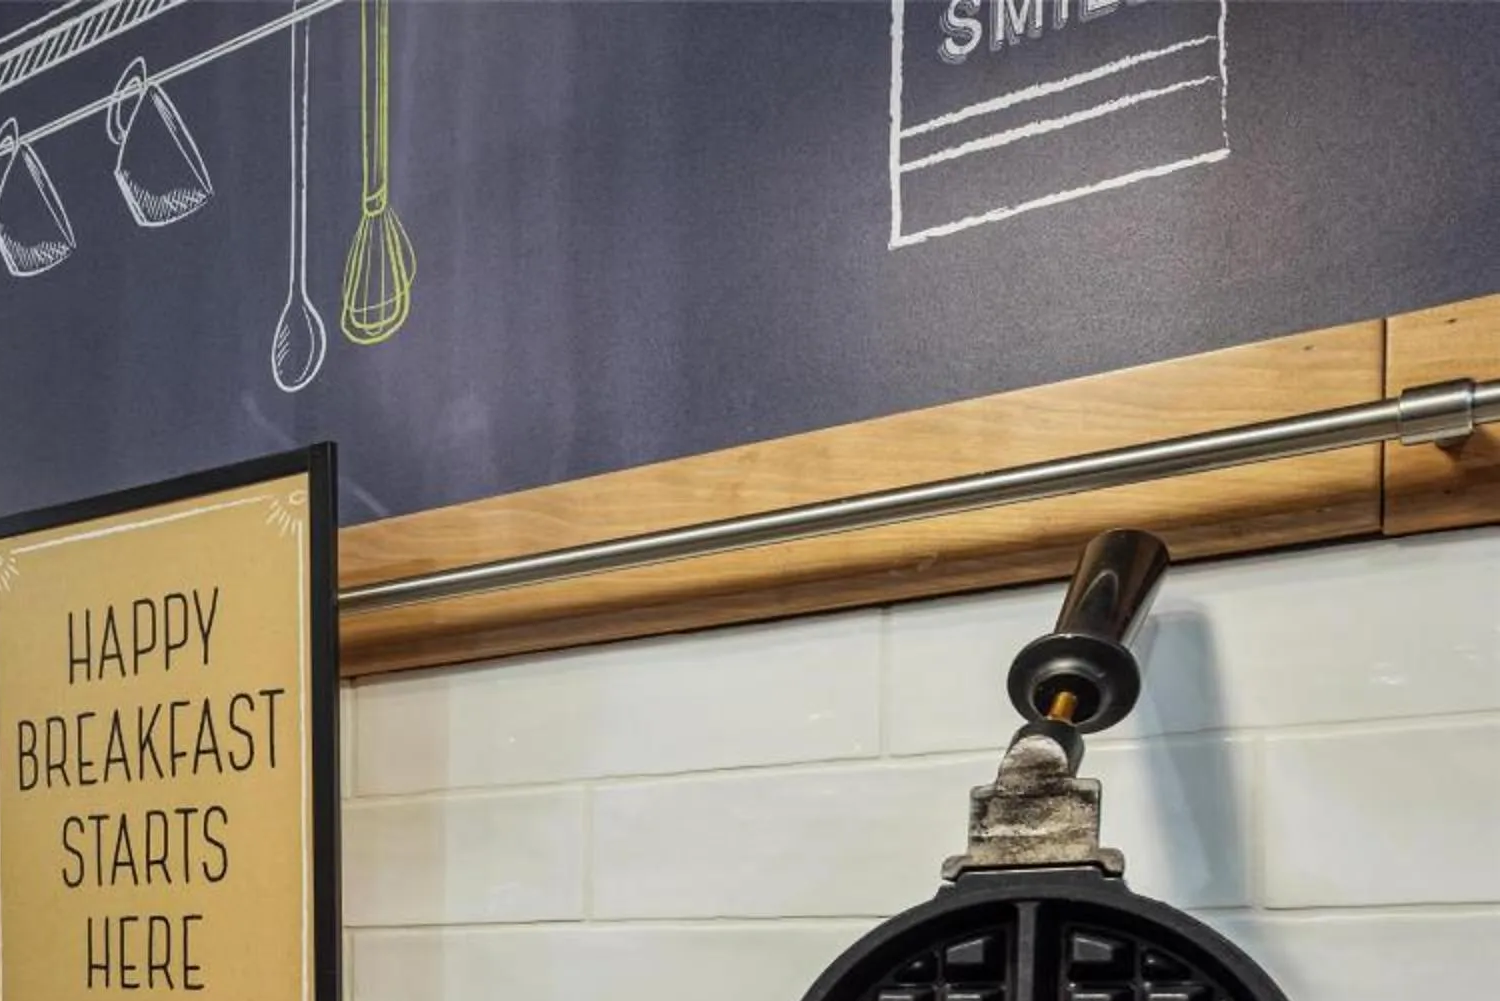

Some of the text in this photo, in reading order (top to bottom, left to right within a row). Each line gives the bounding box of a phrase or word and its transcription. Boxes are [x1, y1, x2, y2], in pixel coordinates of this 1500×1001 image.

[68, 586, 219, 684] HAPPY
[18, 689, 285, 791] BREAKFAST
[62, 805, 229, 888] STARTS
[86, 915, 205, 991] HERE
